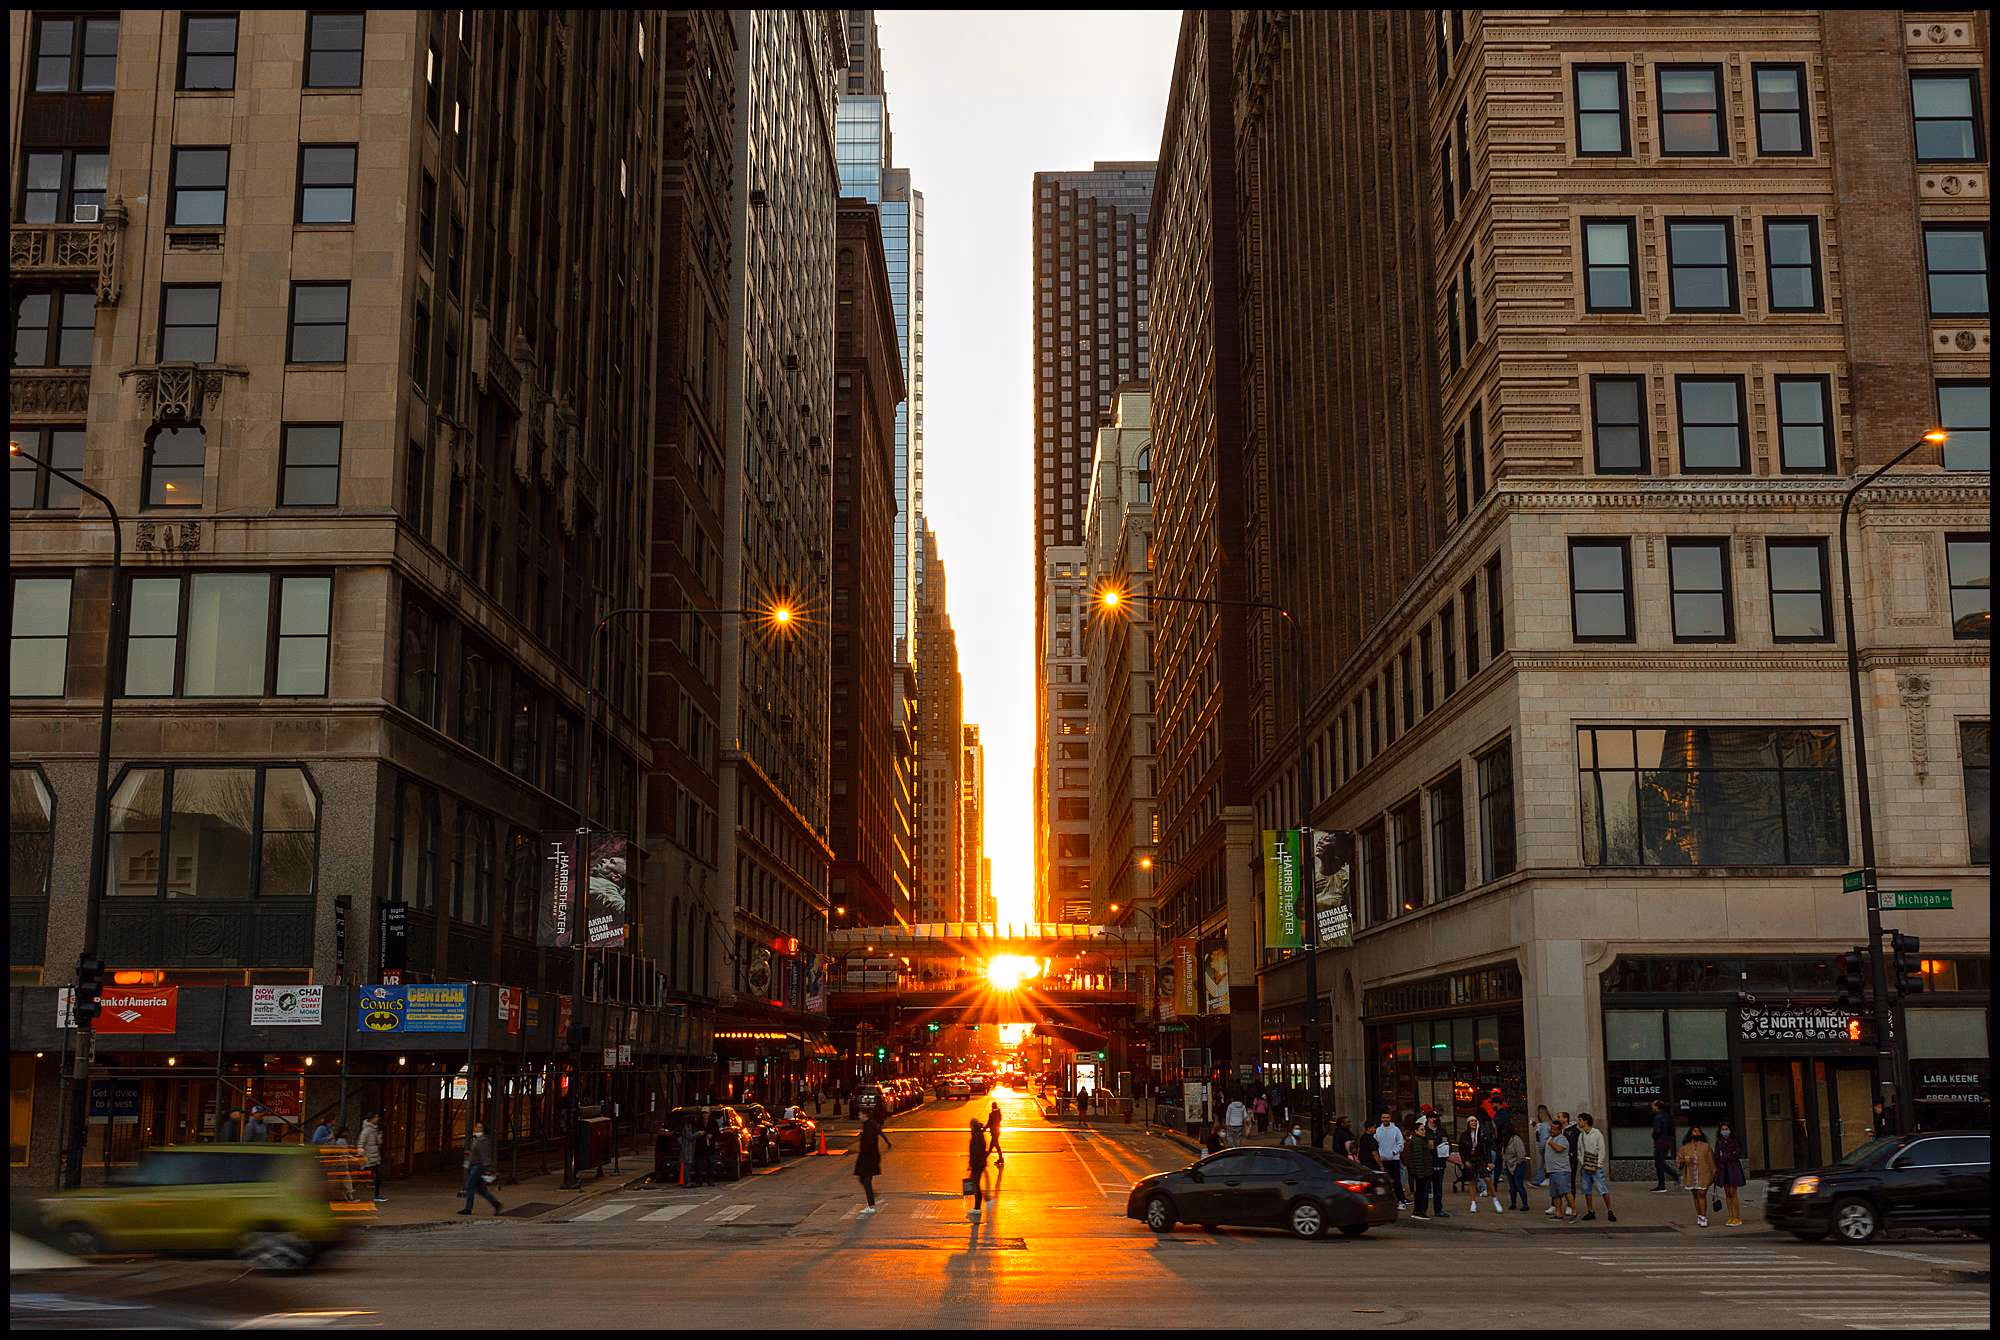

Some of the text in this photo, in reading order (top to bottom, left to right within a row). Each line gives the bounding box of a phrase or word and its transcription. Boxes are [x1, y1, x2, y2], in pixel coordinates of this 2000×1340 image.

[556, 855, 569, 935] HARRIS THEATER
[1283, 855, 1294, 935] HARRIS THEATER
[1897, 894, 1941, 908] Michigan
[1316, 904, 1349, 920] NATHALIE
[588, 914, 614, 928] AKRAM
[588, 923, 609, 936] KHAN
[590, 927, 624, 942] COMPANY
[1320, 922, 1349, 935] SPEKTRAL
[1322, 929, 1347, 942] QUARTET
[298, 988, 321, 996] CHAI
[407, 987, 465, 1002] CENTRAL
[119, 996, 129, 1007] of
[129, 996, 168, 1007] America
[1759, 1017, 1850, 1029] 2 NORTH MICH
[1623, 1076, 1653, 1085] RETAIL
[1923, 1074, 1980, 1083] LARA KEENE
[110, 1087, 139, 1098] dvice
[1616, 1086, 1661, 1094] FOR LEASE
